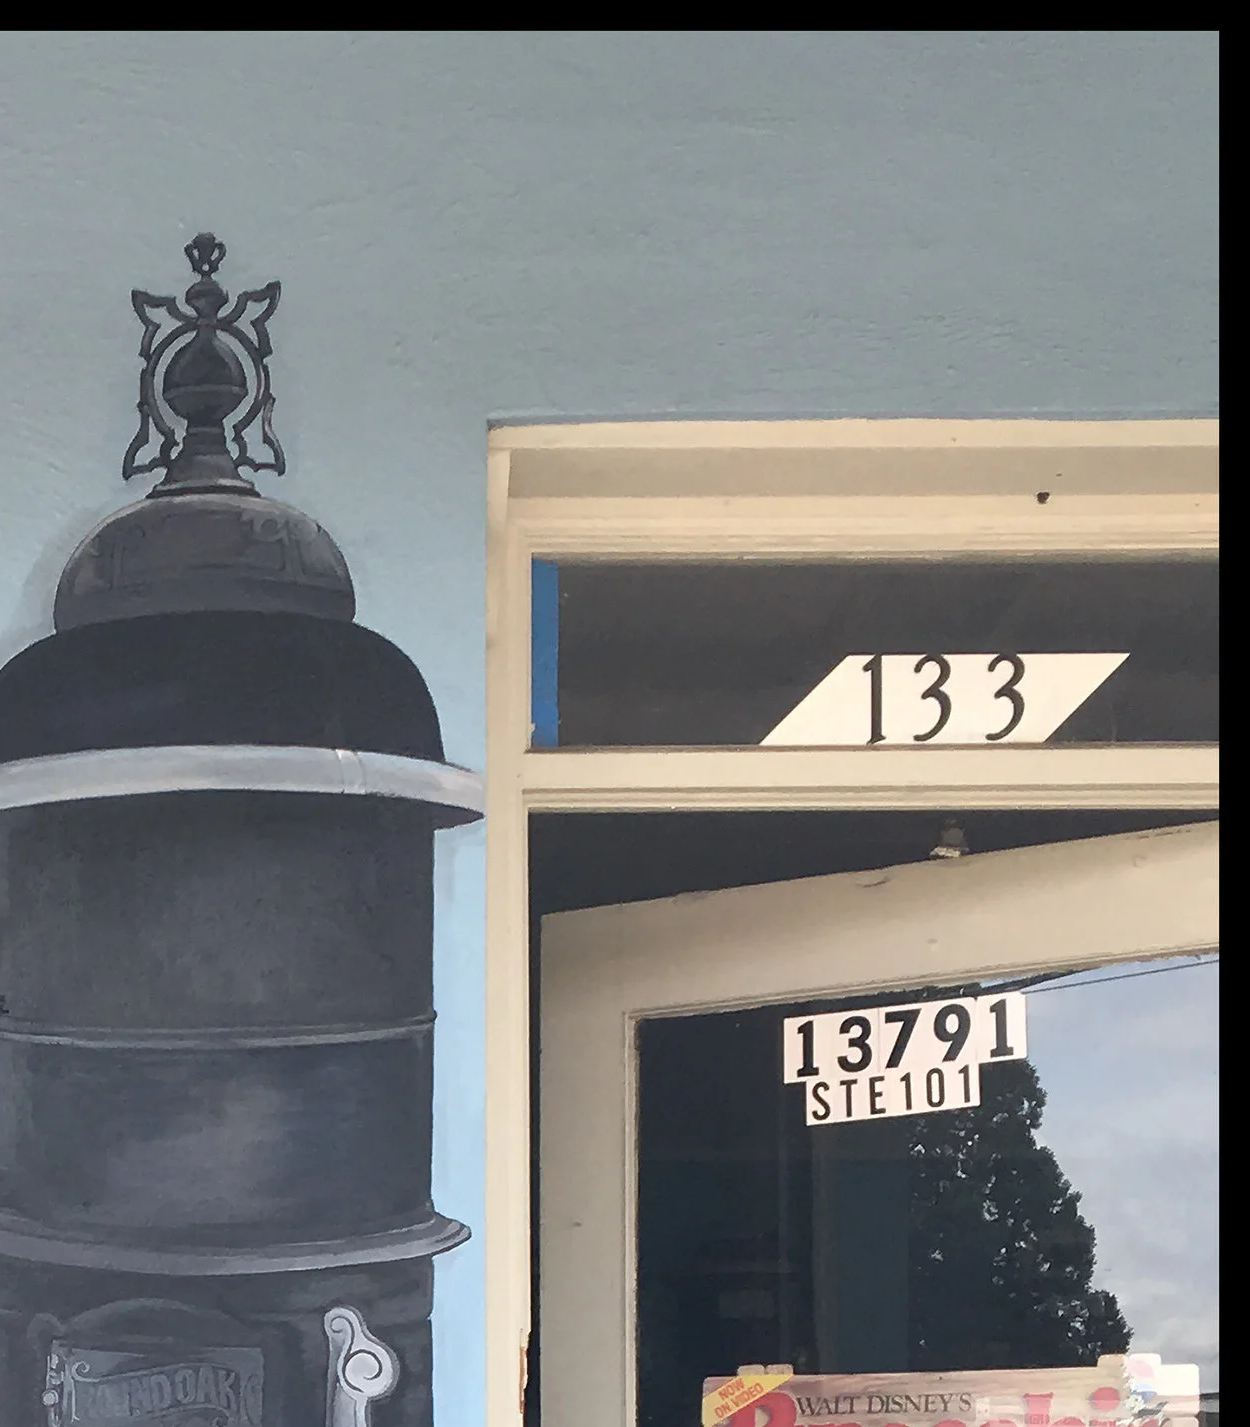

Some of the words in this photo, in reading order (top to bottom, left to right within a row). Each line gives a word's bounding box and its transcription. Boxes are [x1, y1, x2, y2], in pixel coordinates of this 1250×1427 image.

[862, 653, 1026, 745] 133
[796, 999, 1015, 1077] 13791
[174, 1366, 238, 1411] OAK
[714, 1402, 732, 1418] ON
[730, 1382, 764, 1407] VIDEO
[718, 1378, 745, 1400] NOW
[796, 1395, 860, 1416] WALT
[867, 1387, 972, 1414] DISNEY'S
